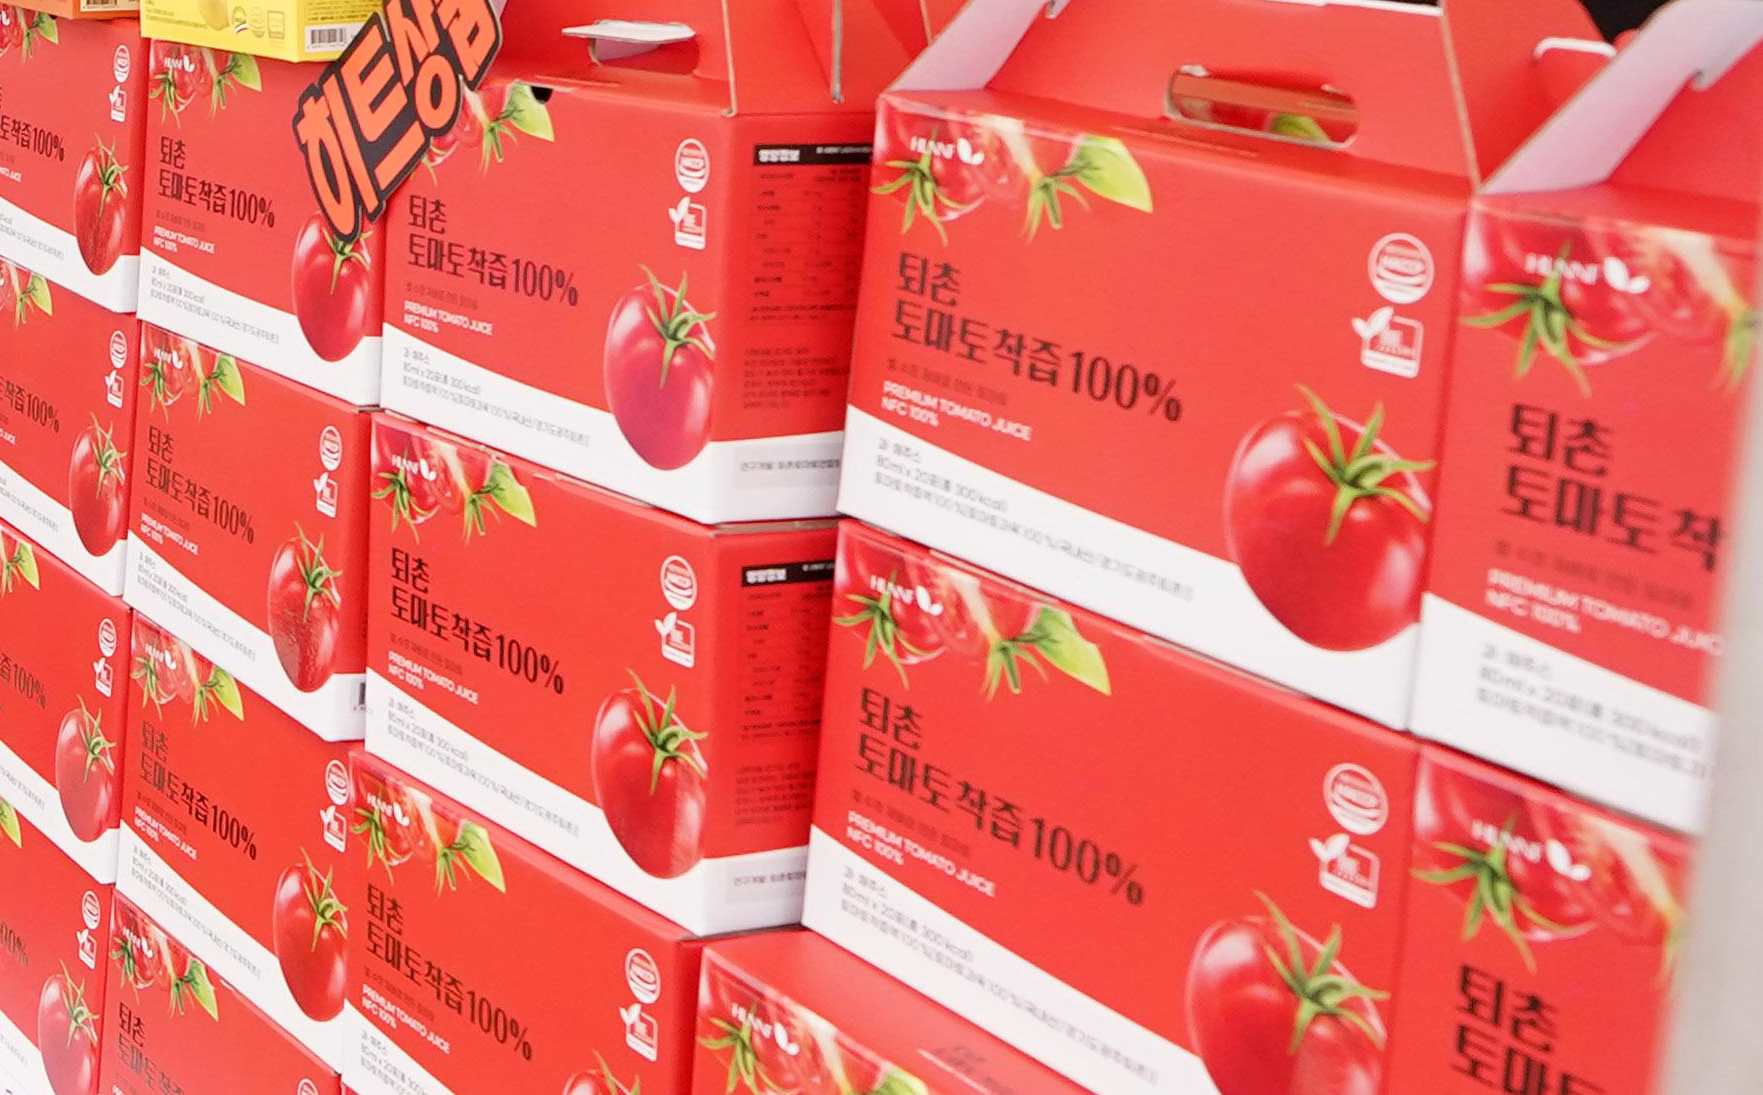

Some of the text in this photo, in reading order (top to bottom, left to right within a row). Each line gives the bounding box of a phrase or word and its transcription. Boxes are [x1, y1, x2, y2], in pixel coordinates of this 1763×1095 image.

[160, 136, 186, 169] 퇴촌
[409, 195, 447, 234] 퇴촌
[897, 251, 961, 307] 퇴촌
[881, 396, 939, 427] NFC 100%
[883, 380, 939, 410] PREMIUM
[940, 398, 992, 428] TOMATO
[991, 414, 1034, 441] JUICE
[149, 426, 174, 464] 퇴촌
[1503, 403, 1613, 477] 퇴촌
[1501, 464, 1722, 571] 토마토착
[391, 546, 431, 594] 퇴촌
[141, 720, 167, 761] 퇴촌
[860, 687, 923, 751] 퇴촌
[846, 825, 905, 866] NFC 100%
[847, 809, 902, 849] PREMIUM
[903, 836, 956, 877] TOMATO
[955, 867, 996, 898] JUICE
[367, 883, 404, 937] 퇴촌
[1457, 963, 1555, 1054] 퇴촌
